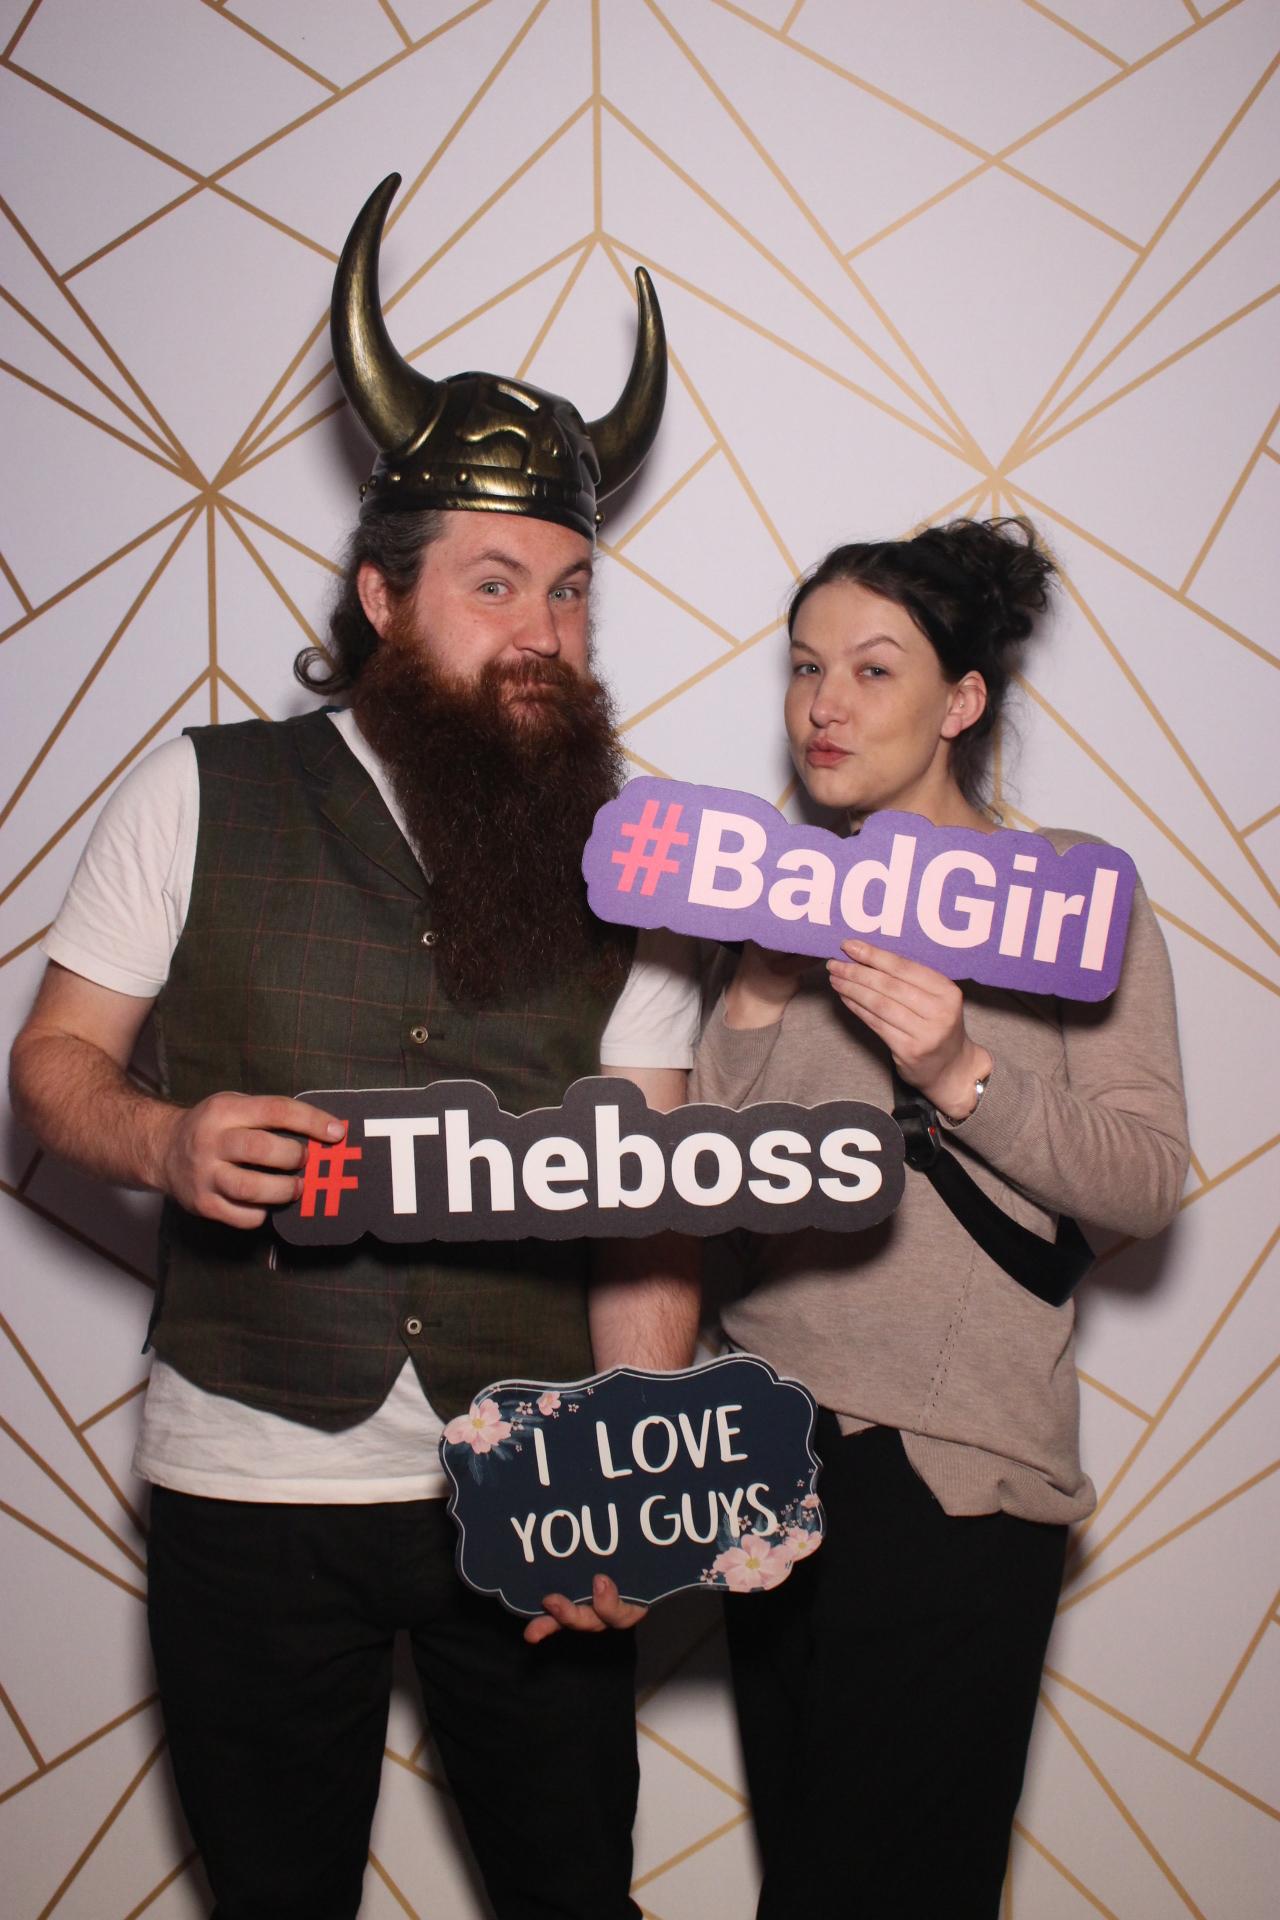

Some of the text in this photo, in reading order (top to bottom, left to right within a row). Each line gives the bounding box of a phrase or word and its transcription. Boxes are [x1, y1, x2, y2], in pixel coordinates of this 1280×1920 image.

[611, 799, 1119, 971] #BadGirl
[299, 1104, 882, 1218] #Theboss
[533, 1404, 748, 1486] I LOVE
[510, 1482, 778, 1563] YOU GUYS
